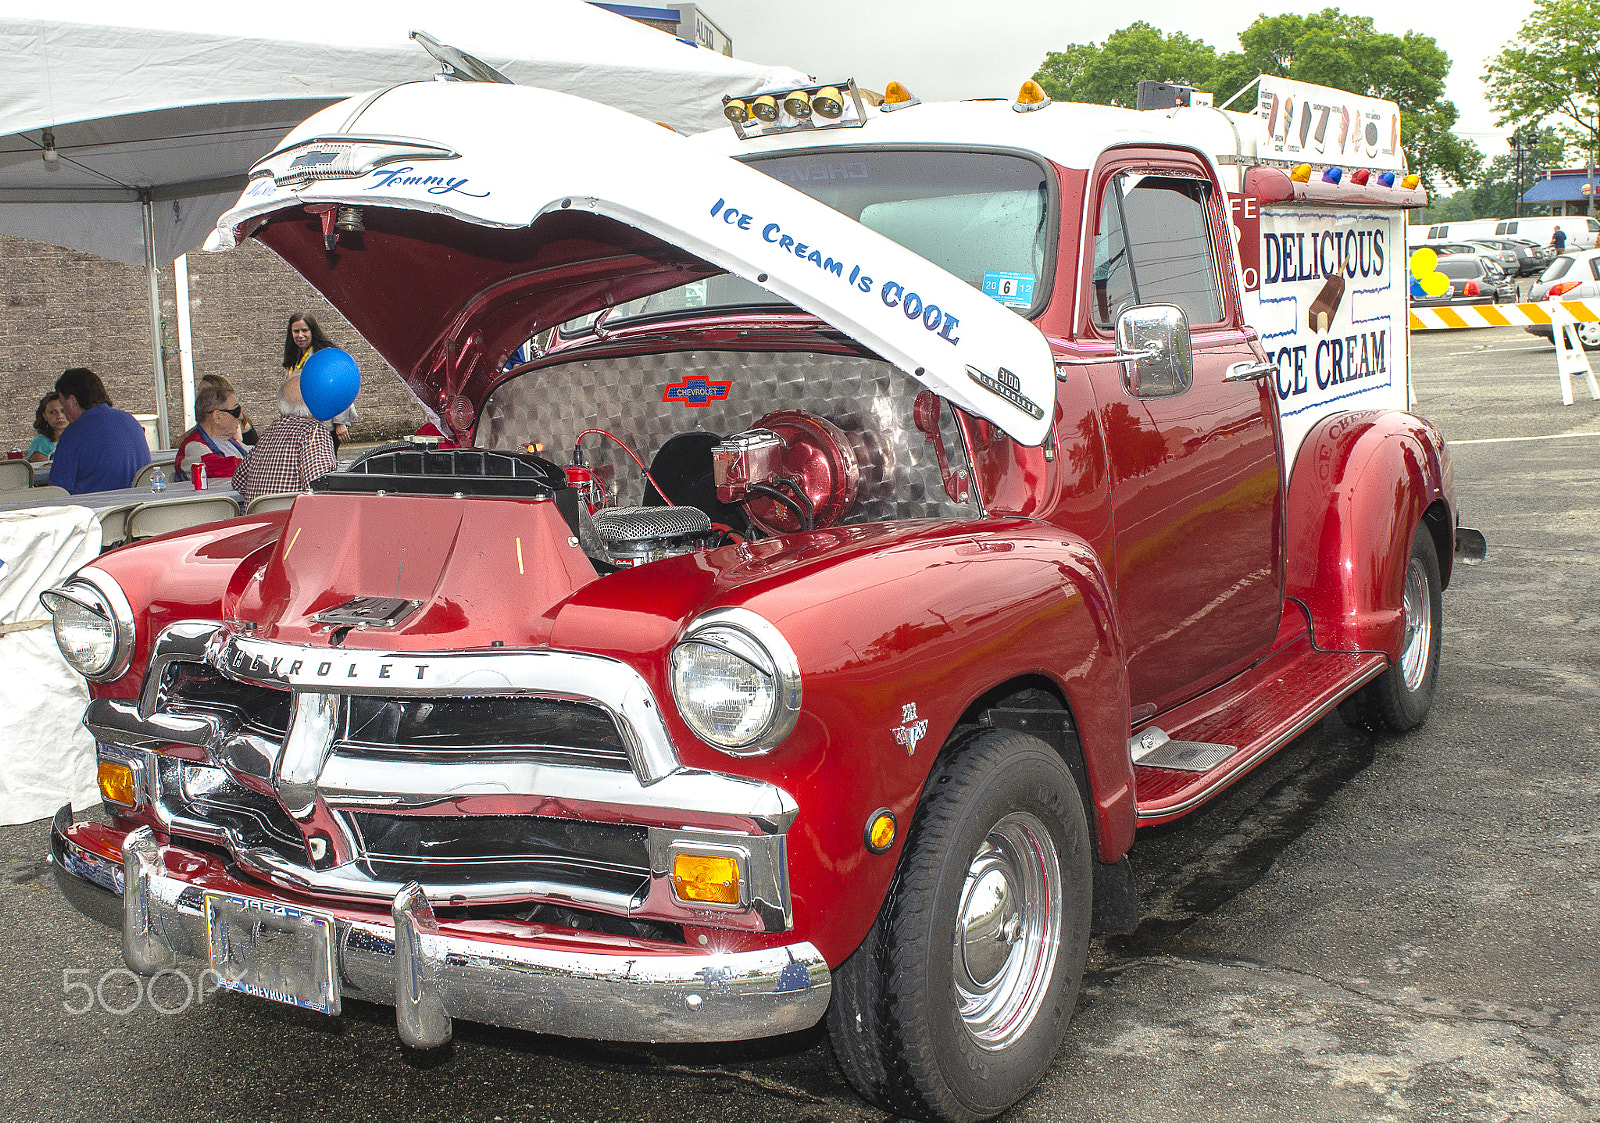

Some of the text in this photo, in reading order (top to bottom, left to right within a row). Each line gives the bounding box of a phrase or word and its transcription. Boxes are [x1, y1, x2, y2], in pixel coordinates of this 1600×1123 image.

[695, 17, 714, 50] AUTO
[364, 166, 491, 197] Tommy
[709, 197, 753, 231] ICE
[880, 280, 960, 346] COOL
[1263, 228, 1385, 284] DELICIOUS
[985, 280, 1032, 294] 20 6 12
[1315, 329, 1387, 391] CREAM
[676, 387, 718, 397] CHEVROLET
[982, 376, 1033, 413] CHEVROLET
[999, 368, 1020, 391] 3100
[222, 647, 430, 681] CHEVROLET
